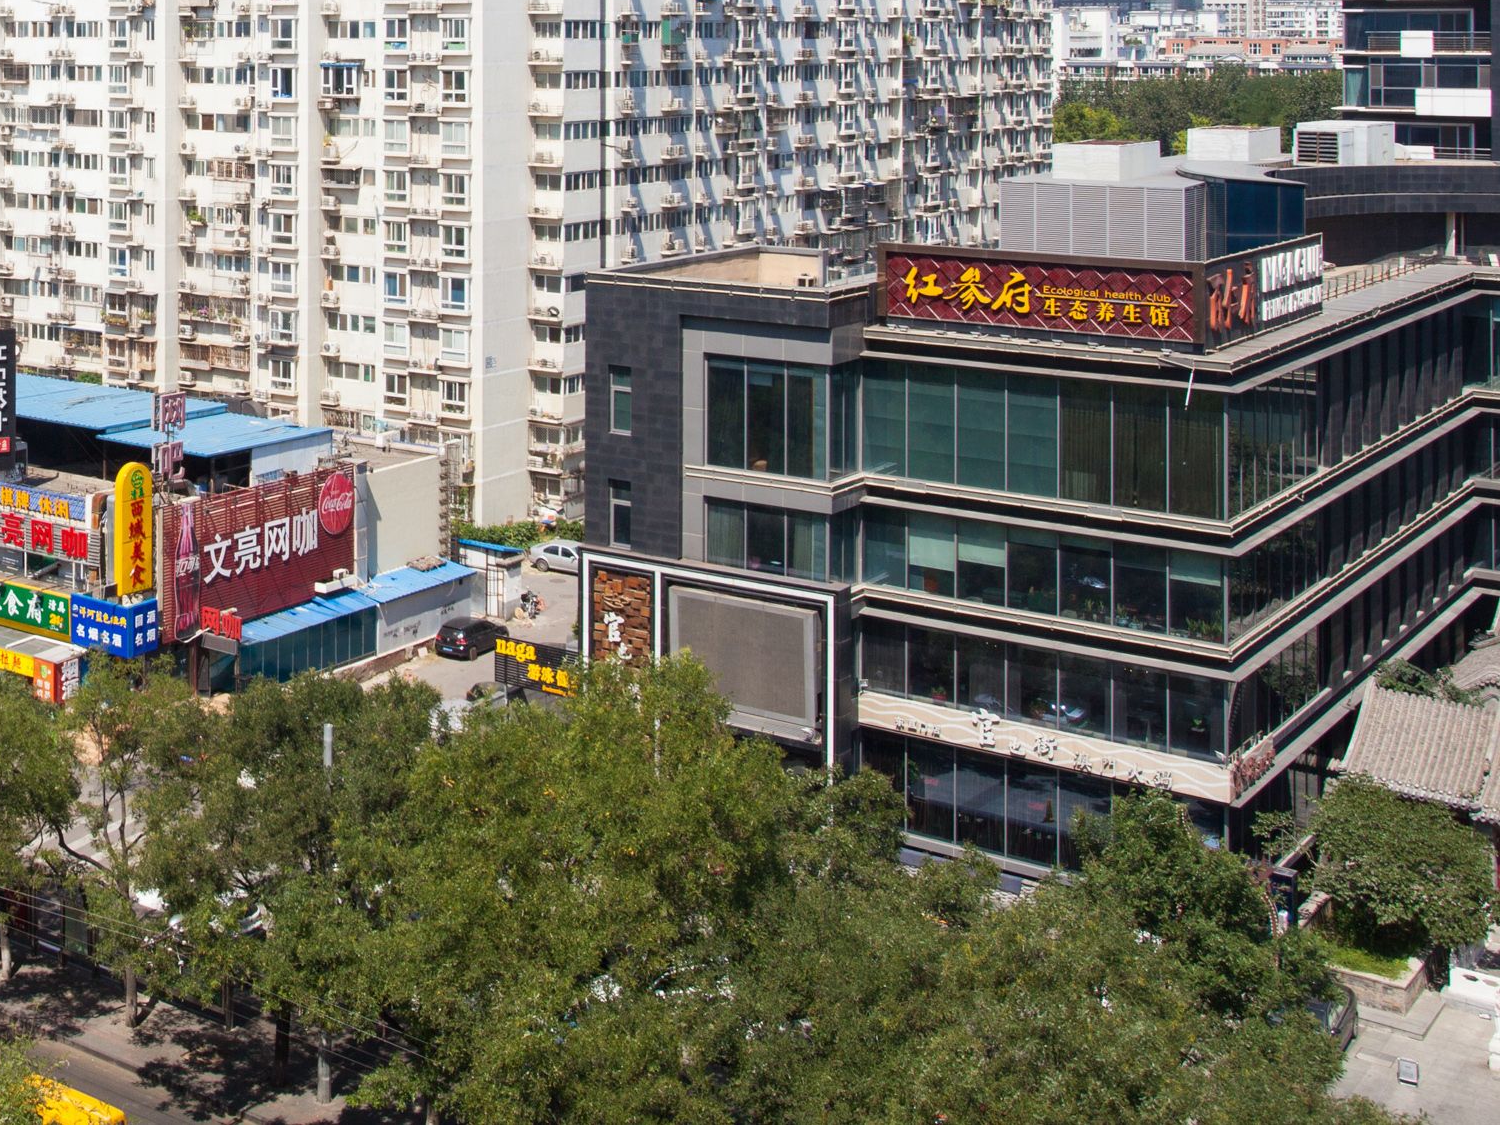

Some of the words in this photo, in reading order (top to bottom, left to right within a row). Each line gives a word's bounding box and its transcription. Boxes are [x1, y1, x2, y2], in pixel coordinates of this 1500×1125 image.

[904, 266, 1032, 314] 红参府
[1043, 285, 1099, 298] Ecological
[1104, 290, 1142, 301] health
[1146, 294, 1171, 303] club
[1043, 298, 1170, 327] 生态养生馆
[160, 391, 186, 480] 网吧
[1, 486, 31, 510] 棋牌
[203, 507, 319, 585] 文亮网咖
[202, 606, 242, 642] 网咖
[495, 638, 537, 662] naga
[527, 663, 578, 691] 游泳健
